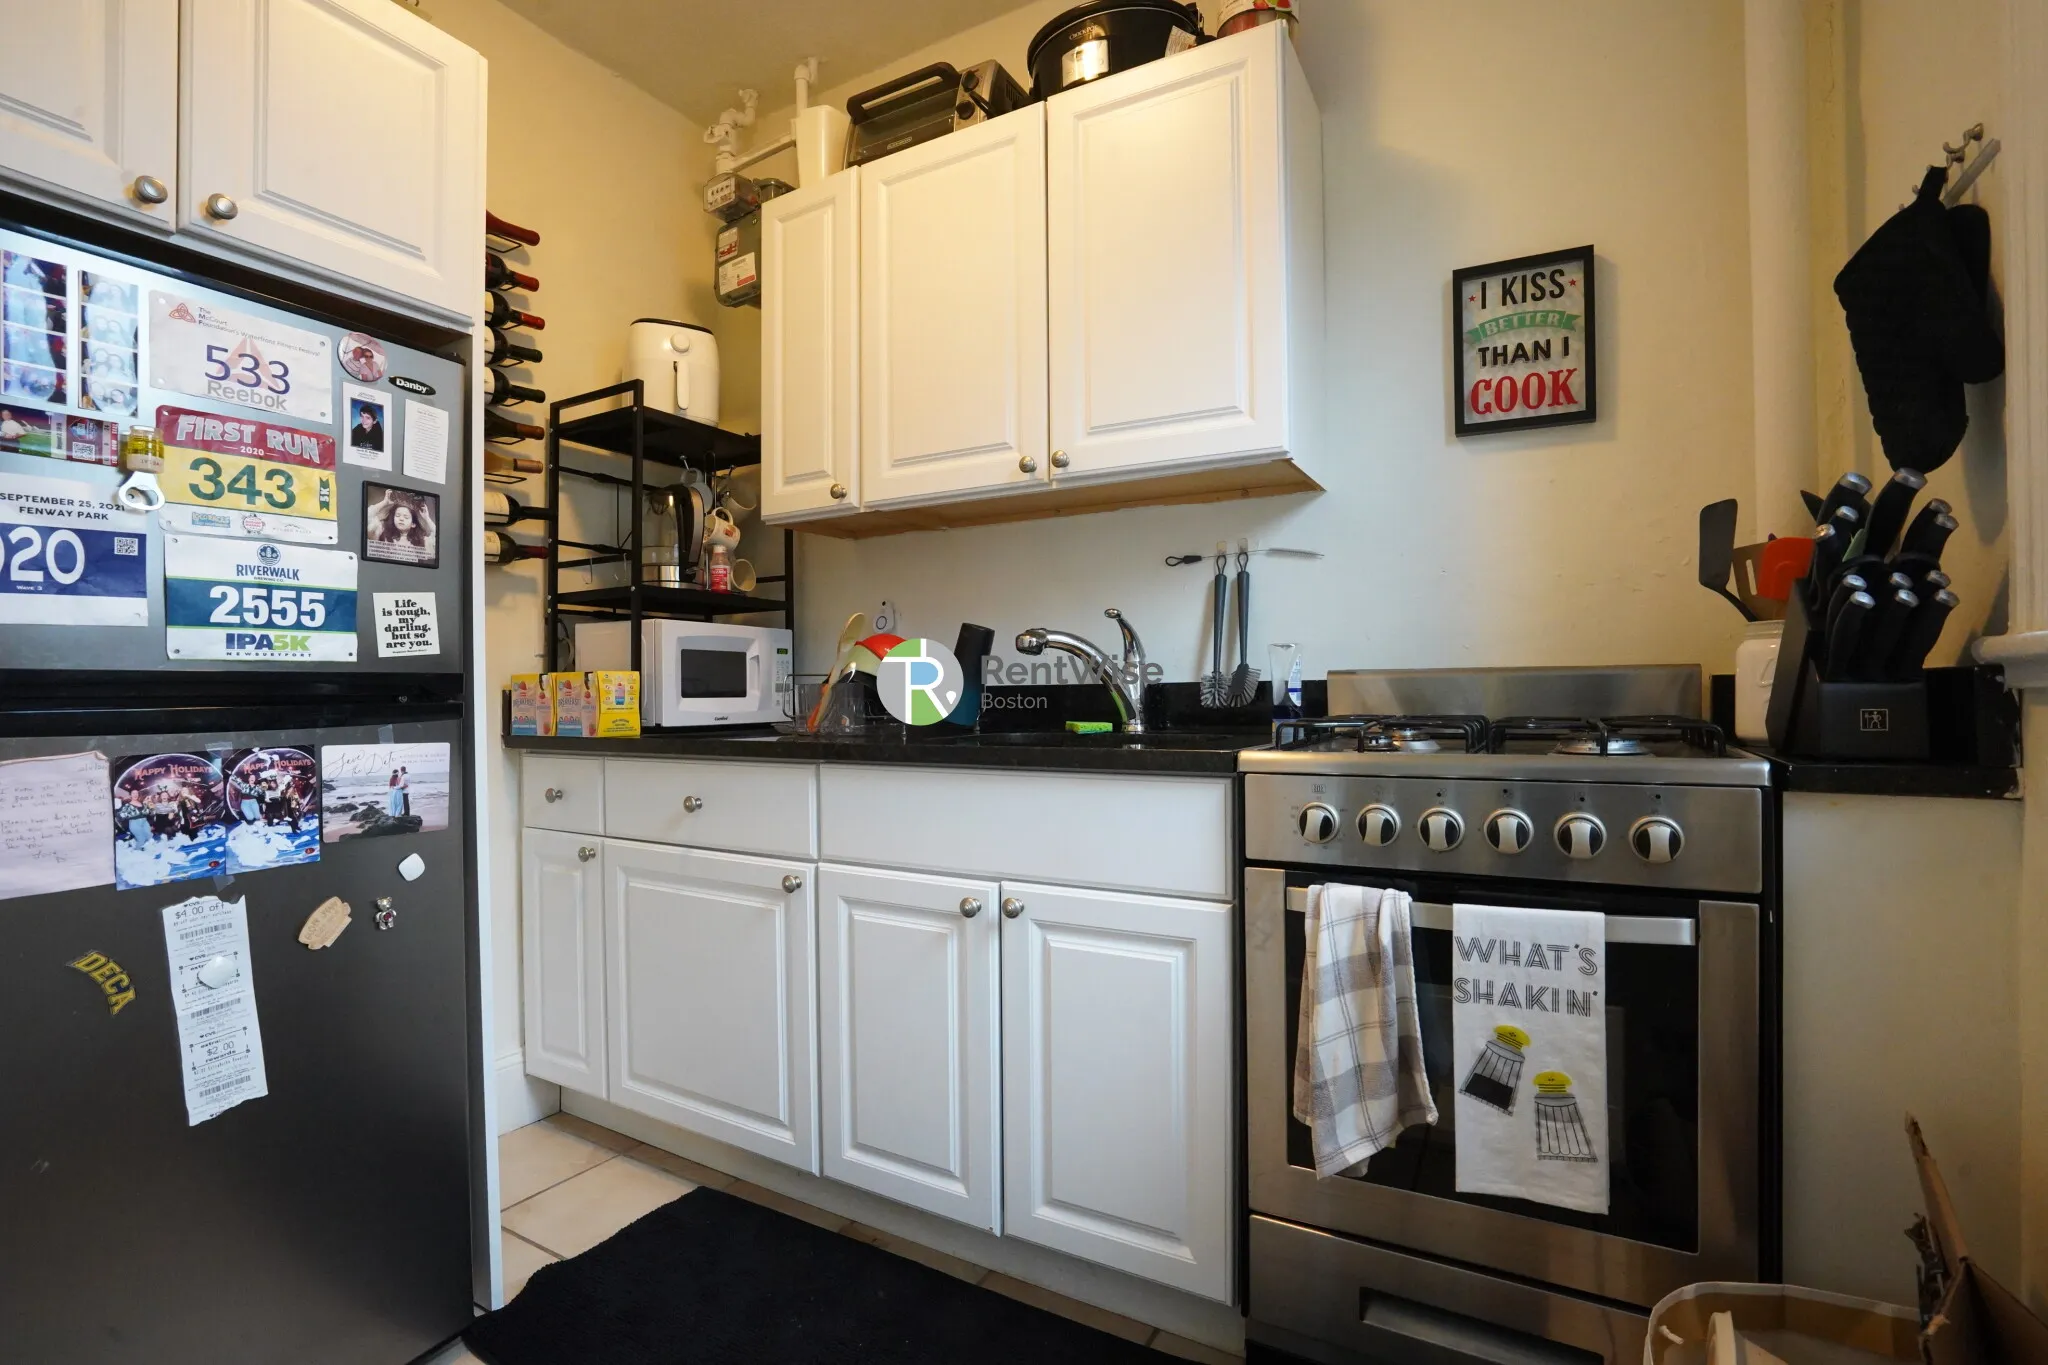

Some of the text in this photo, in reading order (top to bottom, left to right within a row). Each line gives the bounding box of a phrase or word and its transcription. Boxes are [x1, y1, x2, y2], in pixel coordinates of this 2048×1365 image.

[1481, 269, 1565, 310] I KISS
[198, 306, 212, 315] The
[198, 313, 228, 327] McCourt
[1484, 312, 1561, 336] BETTER
[1477, 336, 1570, 369] THAN I
[205, 344, 290, 395] 533
[396, 378, 427, 393] Danby
[1470, 368, 1579, 415] COOK
[207, 380, 287, 411] Reebok
[176, 414, 320, 463] FIRST RUN
[240, 445, 264, 456] 2020
[189, 457, 296, 509] 343
[0, 492, 125, 512] SEPTEMBER 25, 2021
[319, 487, 330, 502] 5K
[19, 506, 109, 521] FENWAY PARK
[0, 525, 85, 585] 20
[236, 564, 299, 581] RIVERWALK
[209, 585, 326, 628] 2555
[394, 599, 417, 608] Life
[382, 607, 431, 618] is tough,
[384, 623, 431, 633] darling,
[398, 617, 416, 626] my
[226, 633, 312, 651] IPA5K
[391, 631, 411, 640] but
[409, 640, 432, 649] you.
[135, 764, 213, 780] HAPPY HOLIDAYS
[274, 758, 312, 770] HOLIDAYS
[1454, 936, 1598, 976] WHAT'S
[72, 951, 137, 1016] DECA
[1453, 977, 1598, 1018] SHAKIN'
[207, 1041, 234, 1056] $2.00
